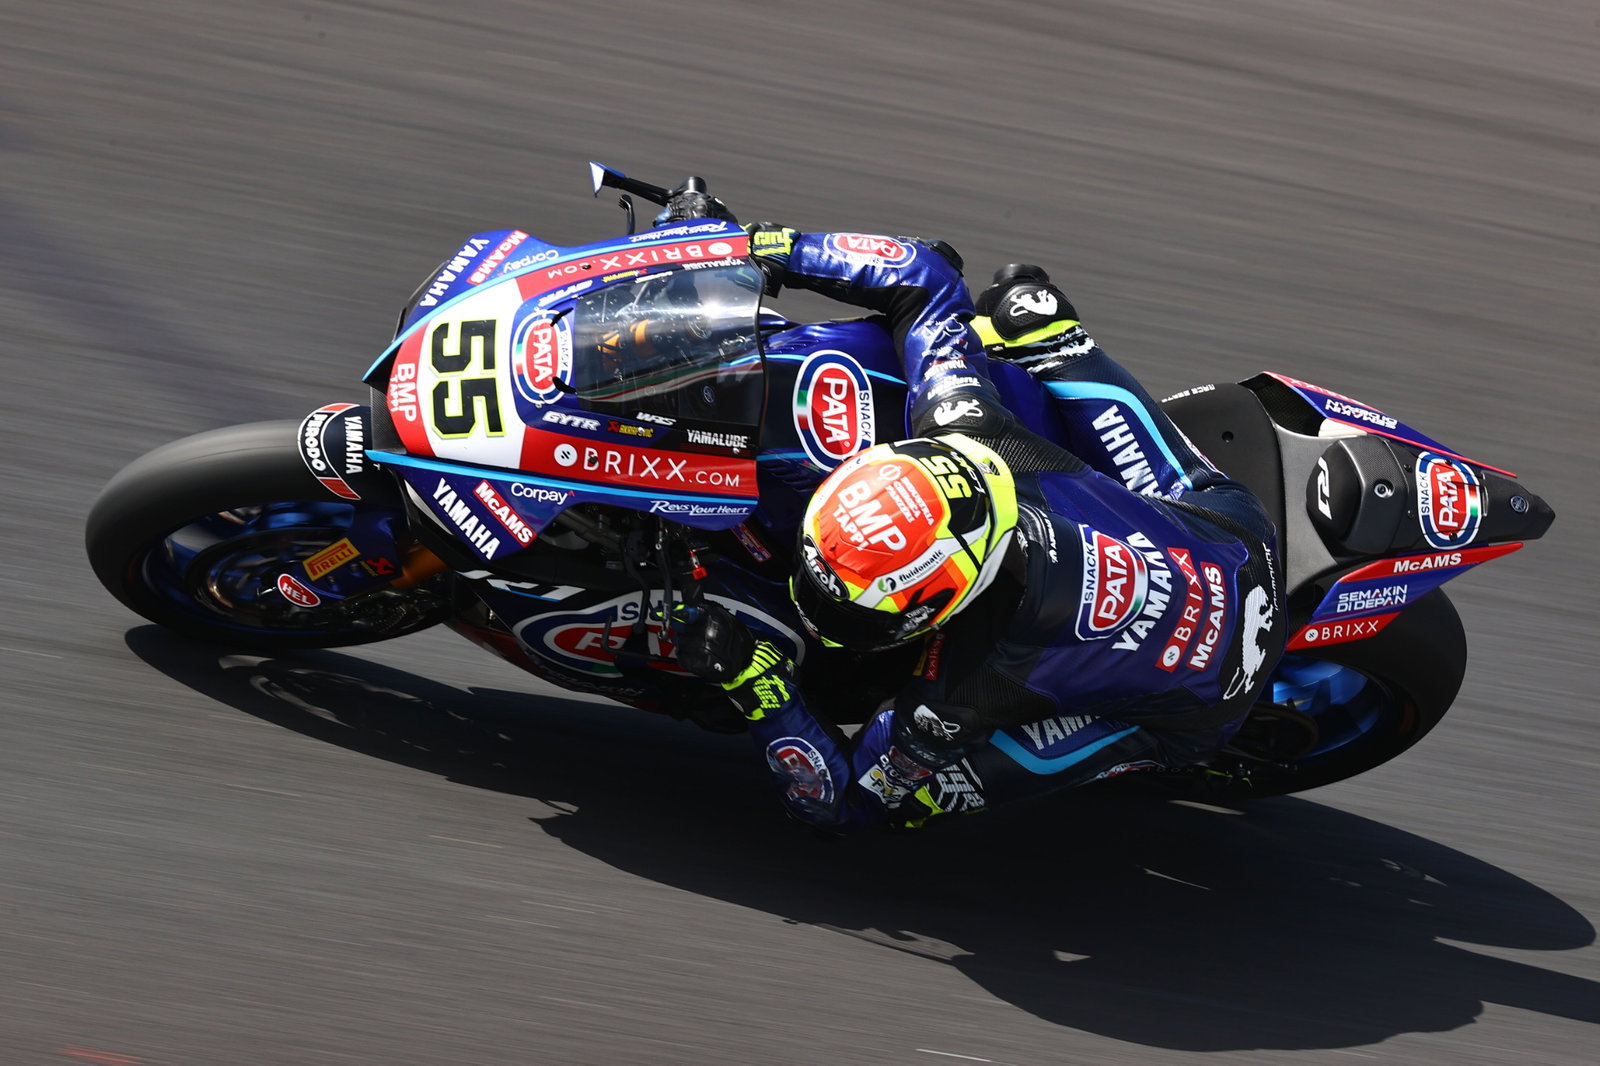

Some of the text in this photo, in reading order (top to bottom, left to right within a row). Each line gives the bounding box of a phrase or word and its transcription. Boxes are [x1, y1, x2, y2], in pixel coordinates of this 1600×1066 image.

[419, 238, 490, 307] YAMAHA
[470, 231, 527, 283] McAMS
[503, 249, 559, 274] Corpay
[846, 236, 898, 257] PATA
[431, 318, 507, 439] 55
[532, 328, 553, 383] PATA
[397, 362, 417, 422] BMP
[822, 376, 849, 444] PATA
[859, 391, 872, 442] SNACK
[344, 415, 364, 474] YAMAHA
[542, 410, 601, 432] GYTR
[687, 429, 749, 448] YAMALUBE
[583, 446, 740, 488] BRIXX.COM
[919, 456, 972, 499] 55
[1092, 404, 1173, 500] AMAHA
[432, 477, 501, 561] YAMAHA
[475, 481, 533, 544] McAMS
[510, 482, 569, 505] Corpay
[649, 500, 750, 516] Revs Your Heart
[837, 480, 907, 551] BMP
[1421, 474, 1430, 516] SNACK
[1439, 470, 1458, 528] PATA
[308, 542, 355, 577] PIRELLI
[803, 544, 841, 597] Airoh
[1085, 545, 1096, 602] SNACK
[1097, 544, 1128, 621] PATA
[1393, 553, 1462, 573] McAMS
[282, 581, 312, 605] HEL
[1111, 531, 1172, 652] YAMAHA
[1171, 551, 1203, 642] BRIXX
[1190, 566, 1225, 668] McAMS
[1337, 595, 1406, 613] DI DEPAN
[1339, 584, 1407, 603] SEMAKIN
[1321, 620, 1379, 640] BRIXX
